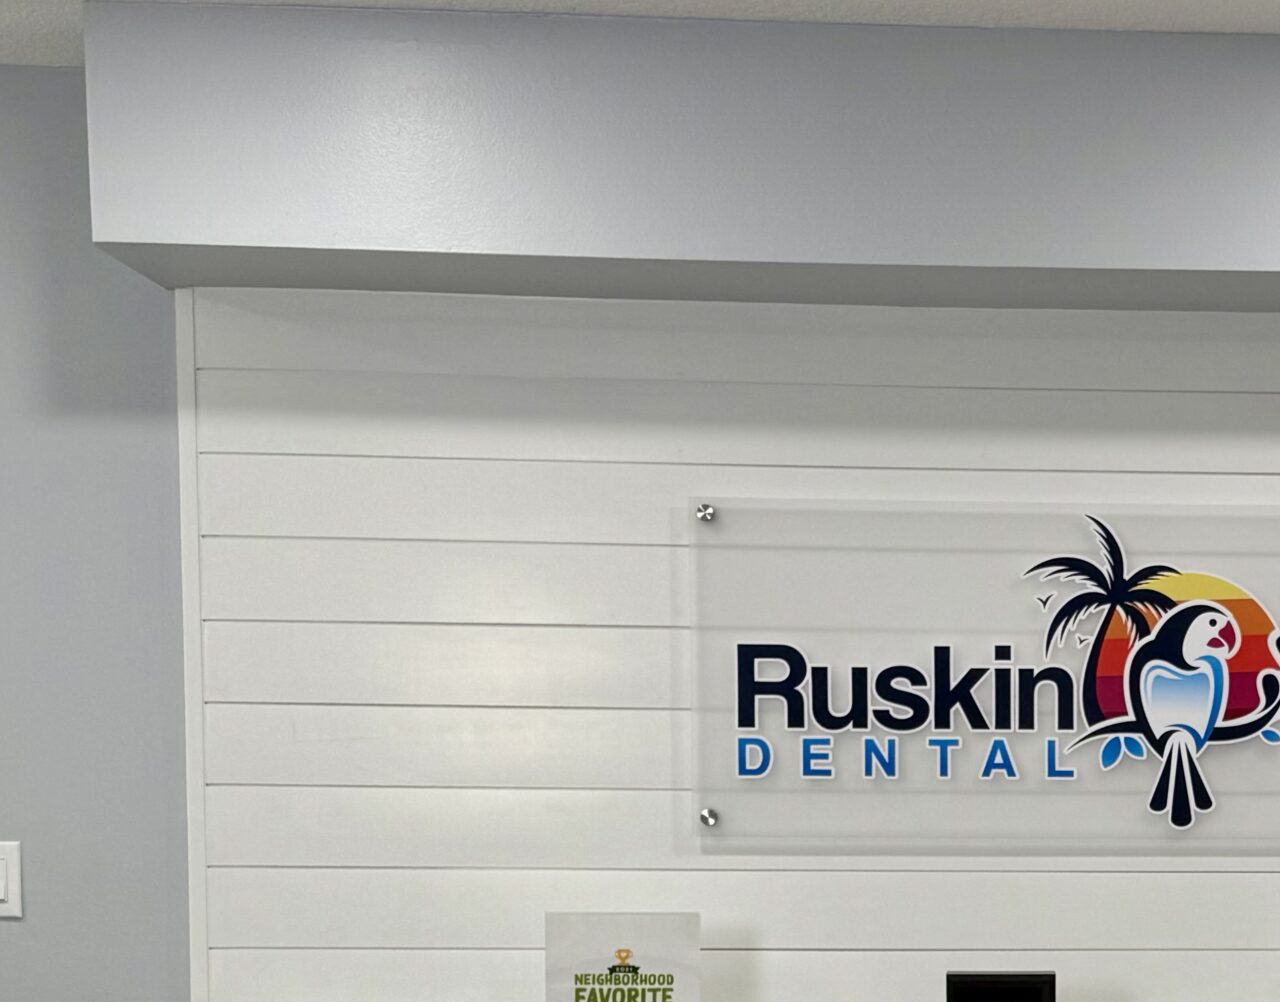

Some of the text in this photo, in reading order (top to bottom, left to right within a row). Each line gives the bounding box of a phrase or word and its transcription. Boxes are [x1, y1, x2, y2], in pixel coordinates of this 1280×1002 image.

[736, 643, 1075, 731] Ruskin
[737, 738, 1075, 778] DENTAL
[574, 973, 674, 986] NEIGHBORHOOD
